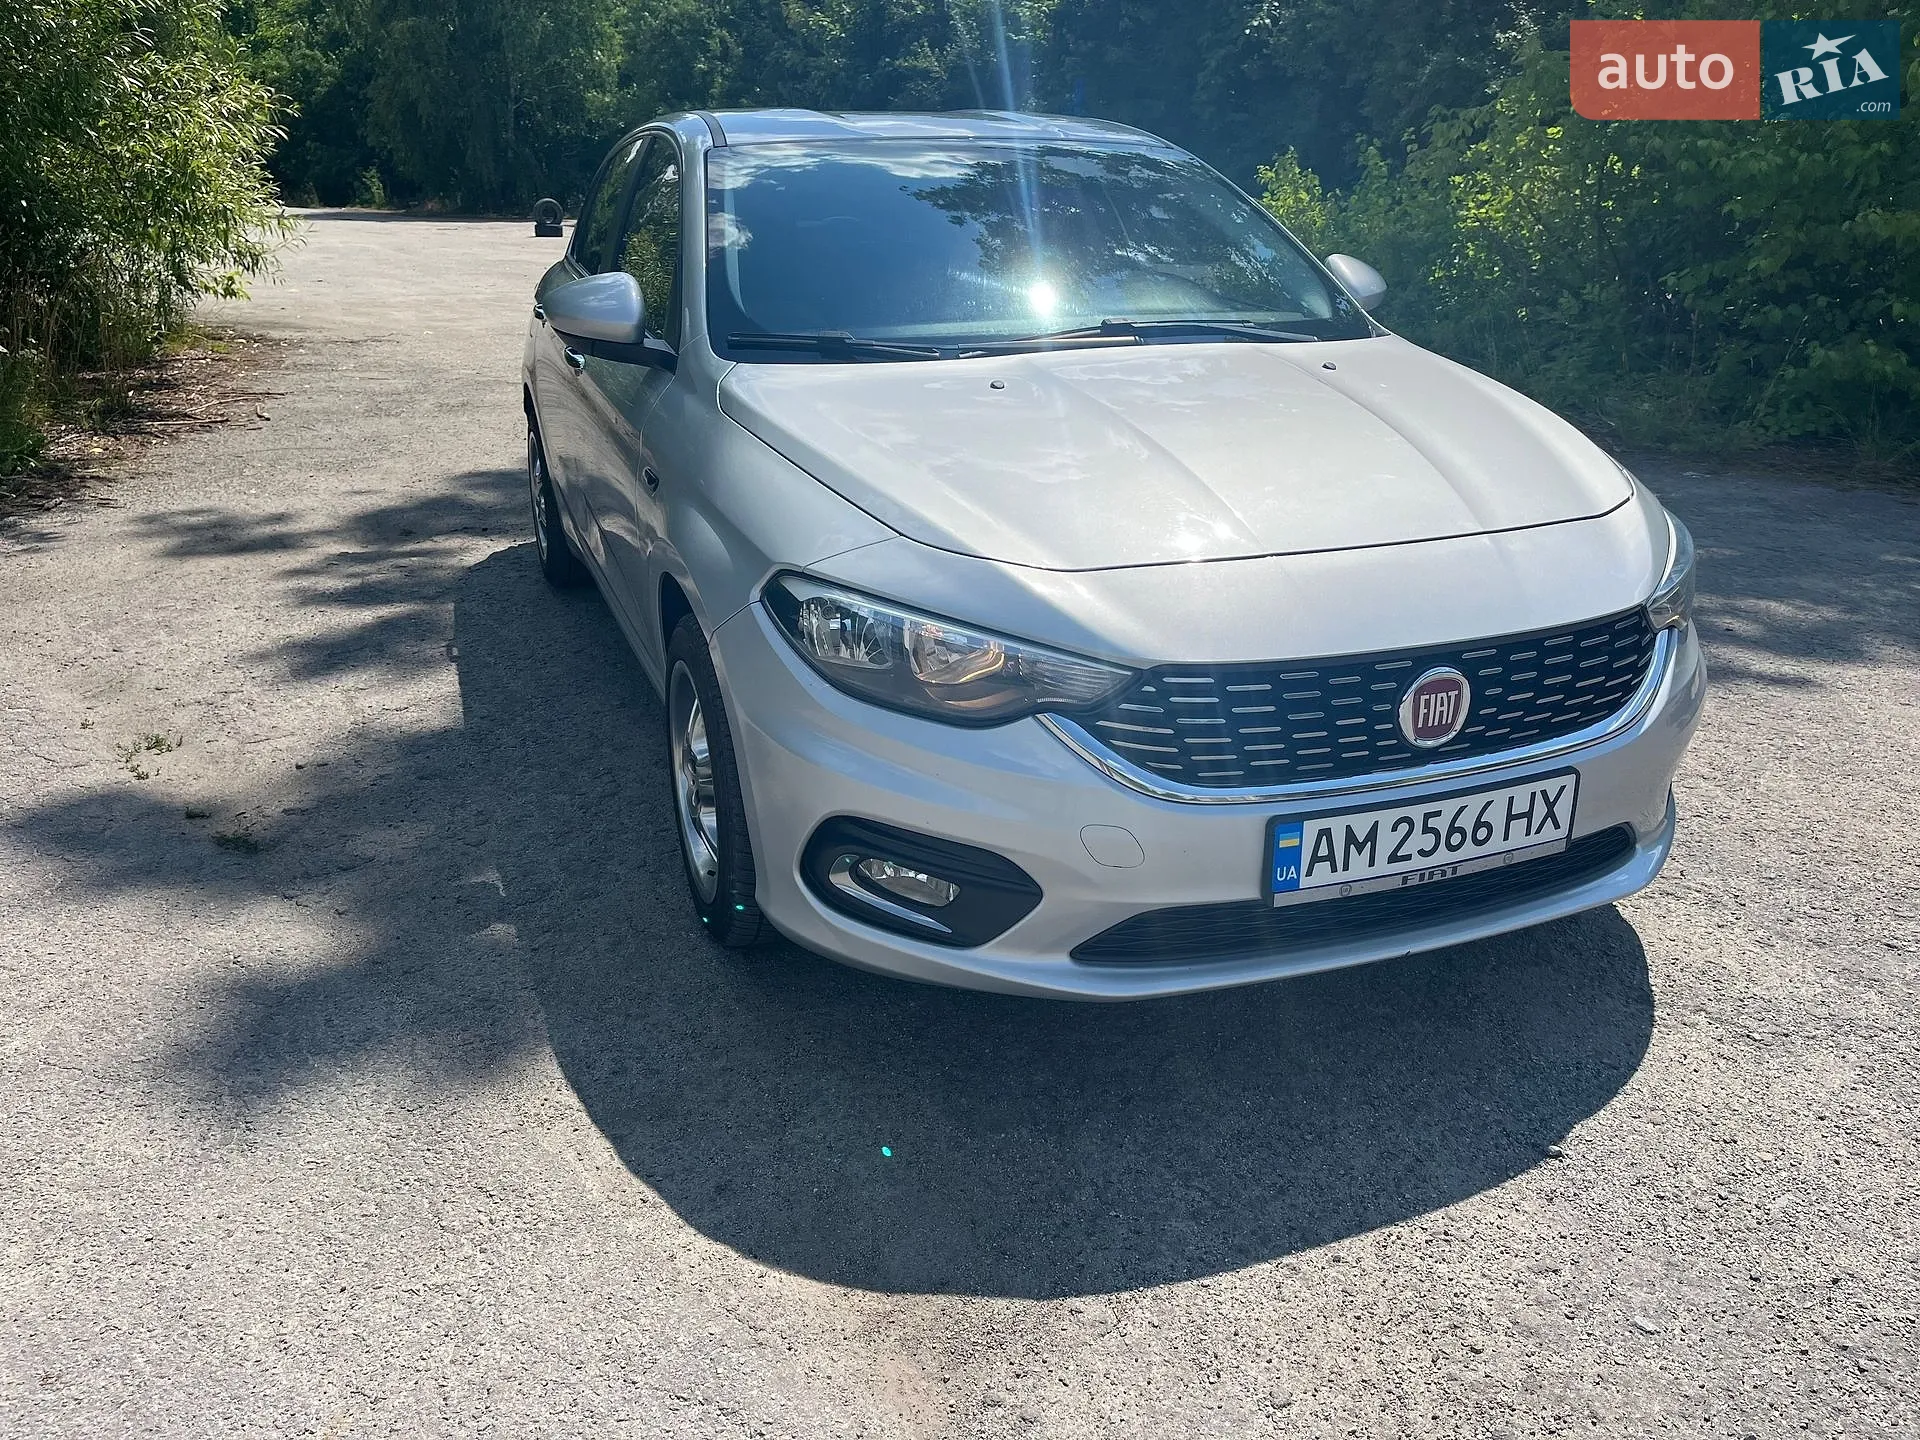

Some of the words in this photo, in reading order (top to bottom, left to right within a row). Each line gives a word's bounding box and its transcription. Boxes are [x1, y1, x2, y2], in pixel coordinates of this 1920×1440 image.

[1417, 690, 1459, 728] FIAT
[1304, 820, 1379, 878] AM
[1387, 799, 1495, 865] 2566
[1503, 784, 1567, 842] HX
[1276, 865, 1297, 882] UA
[1401, 865, 1463, 886] FIAT
